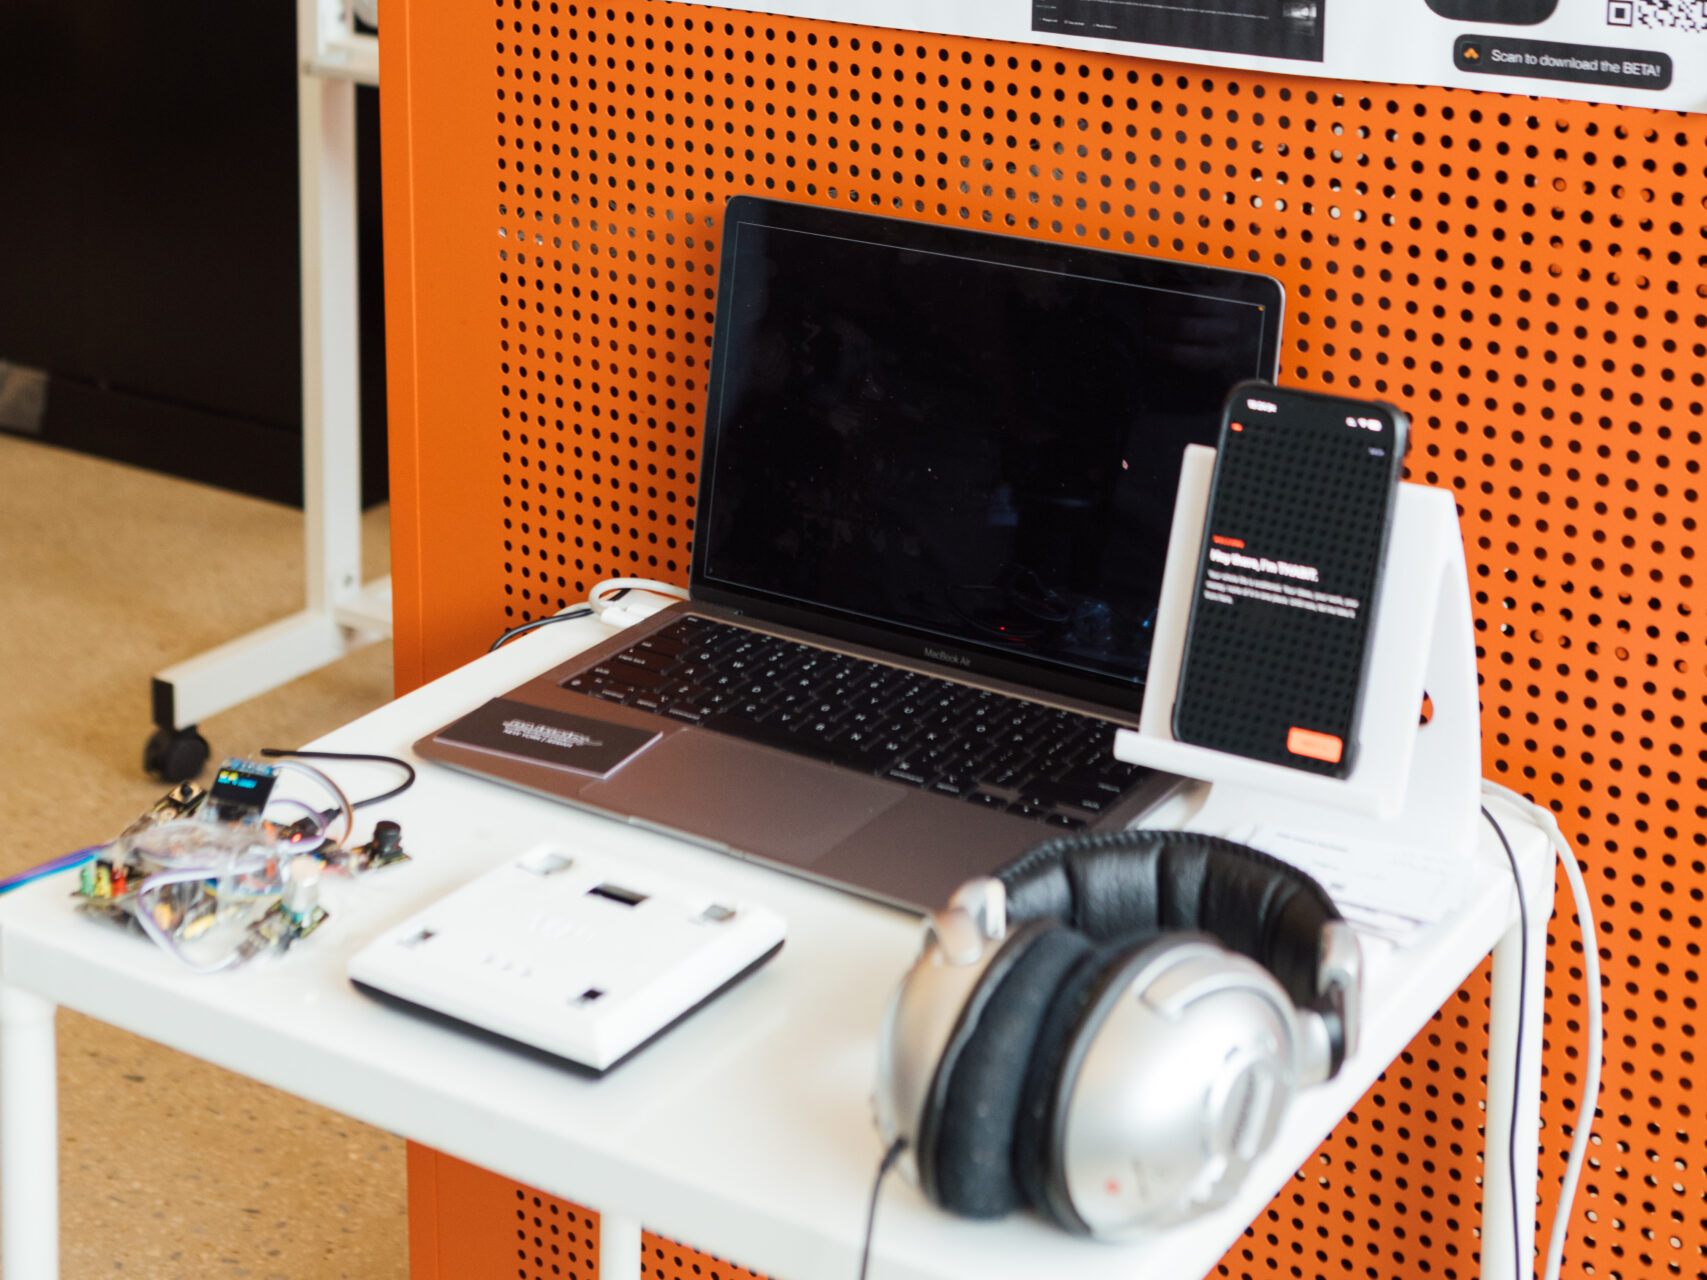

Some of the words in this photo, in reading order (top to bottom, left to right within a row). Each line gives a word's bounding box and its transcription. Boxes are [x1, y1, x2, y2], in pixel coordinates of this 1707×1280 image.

[1491, 48, 1522, 64] Scan
[1525, 52, 1538, 65] to
[1540, 53, 1598, 71] download
[1600, 59, 1620, 74] the
[1622, 61, 1662, 78] BETA!
